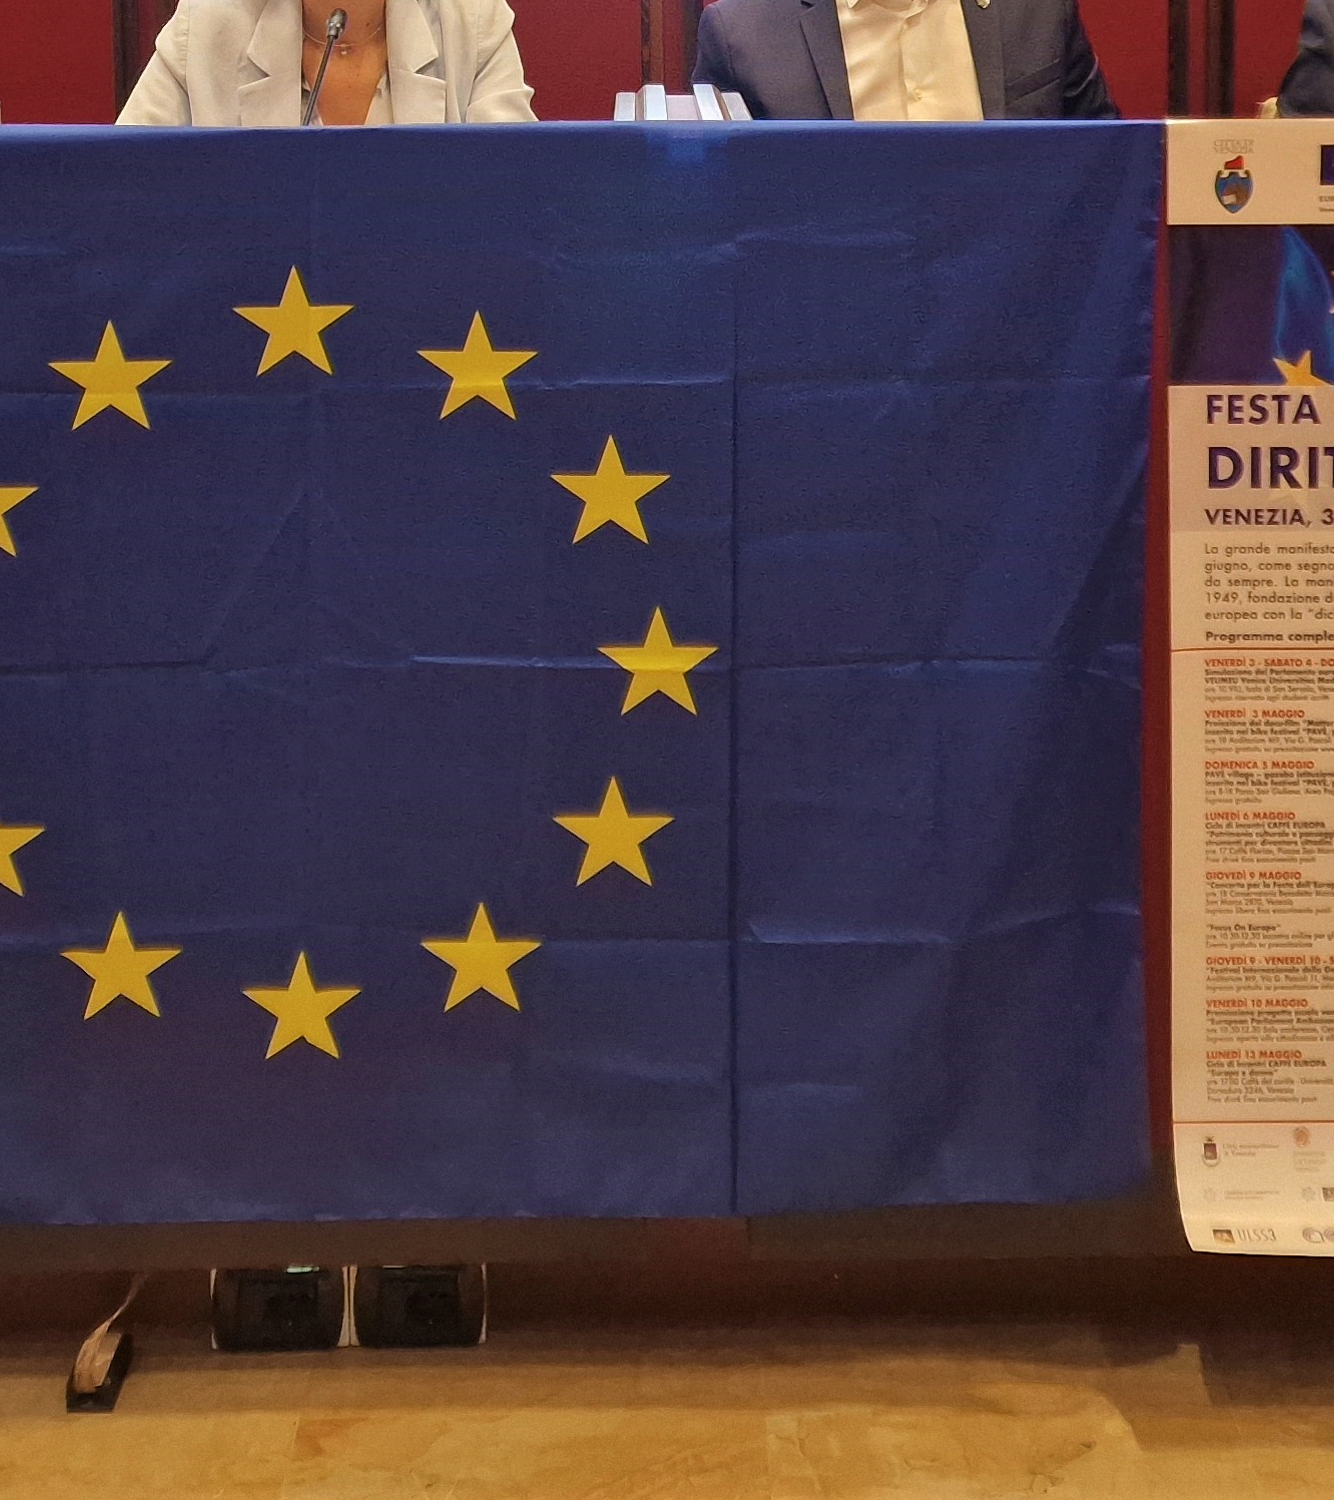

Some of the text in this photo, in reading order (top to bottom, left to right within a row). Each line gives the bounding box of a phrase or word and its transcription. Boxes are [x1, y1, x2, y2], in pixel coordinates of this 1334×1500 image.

[1207, 394, 1320, 424] FESTA
[1205, 508, 1310, 525] VENEZIA,
[1321, 508, 1334, 525] 3
[1205, 542, 1218, 554] La
[1224, 542, 1270, 557] grande
[1204, 559, 1251, 573] giugno,
[1257, 562, 1291, 570] come
[1297, 562, 1334, 573] segno
[1204, 575, 1220, 587] da
[1227, 579, 1277, 590] sempre.
[1284, 575, 1298, 587] La
[1206, 592, 1242, 606] 1949,
[1247, 592, 1319, 603] fondazione
[1204, 612, 1257, 623] europea
[1290, 608, 1302, 619] la
